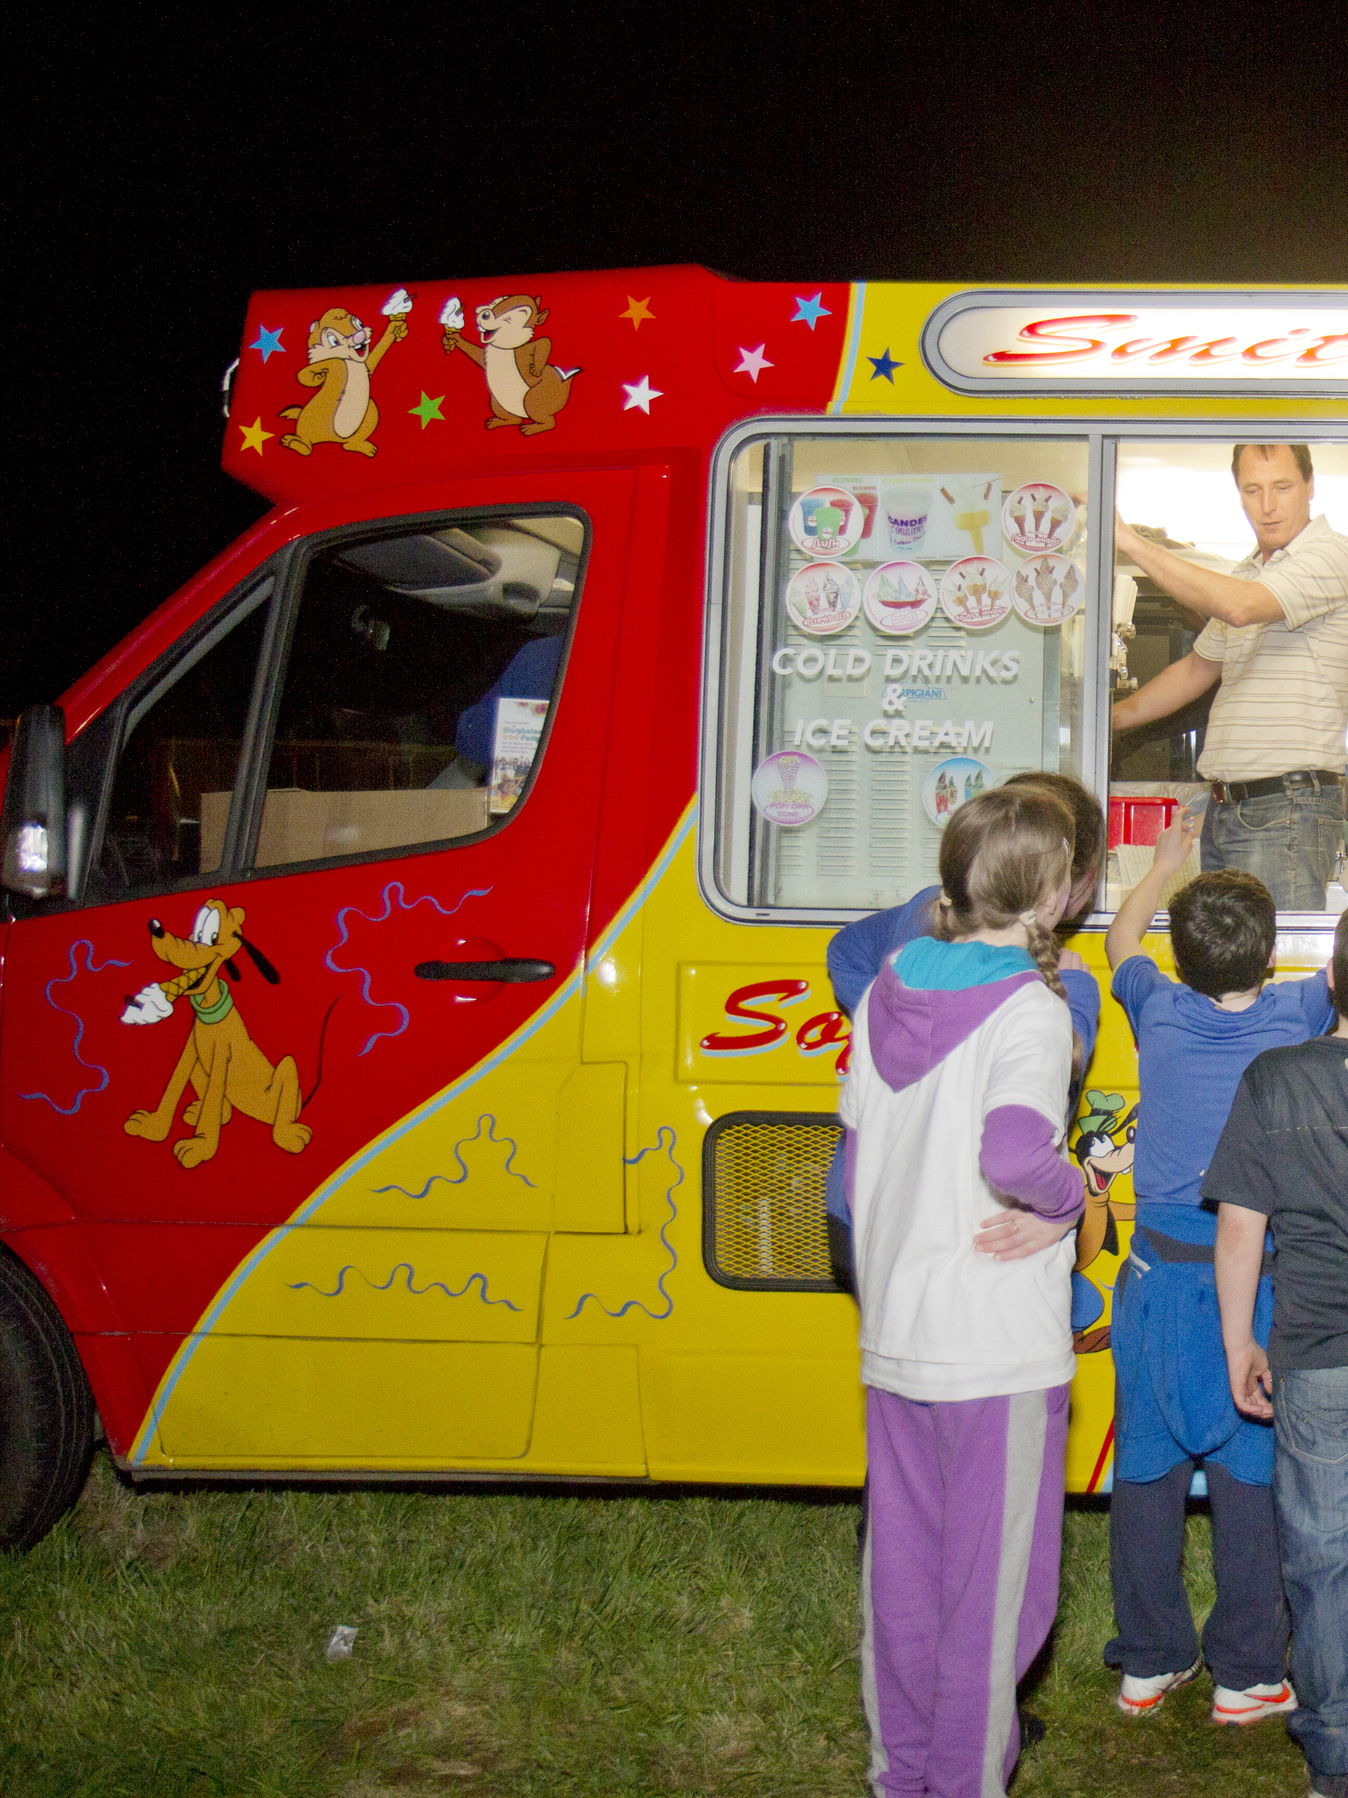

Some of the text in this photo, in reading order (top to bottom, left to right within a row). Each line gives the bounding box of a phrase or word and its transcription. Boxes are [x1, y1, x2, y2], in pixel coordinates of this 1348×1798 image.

[772, 648, 1021, 678] COLD DRINKS
[882, 684, 907, 711] &
[901, 688, 942, 698] RPIGIANI
[794, 718, 994, 748] ICE CREAM
